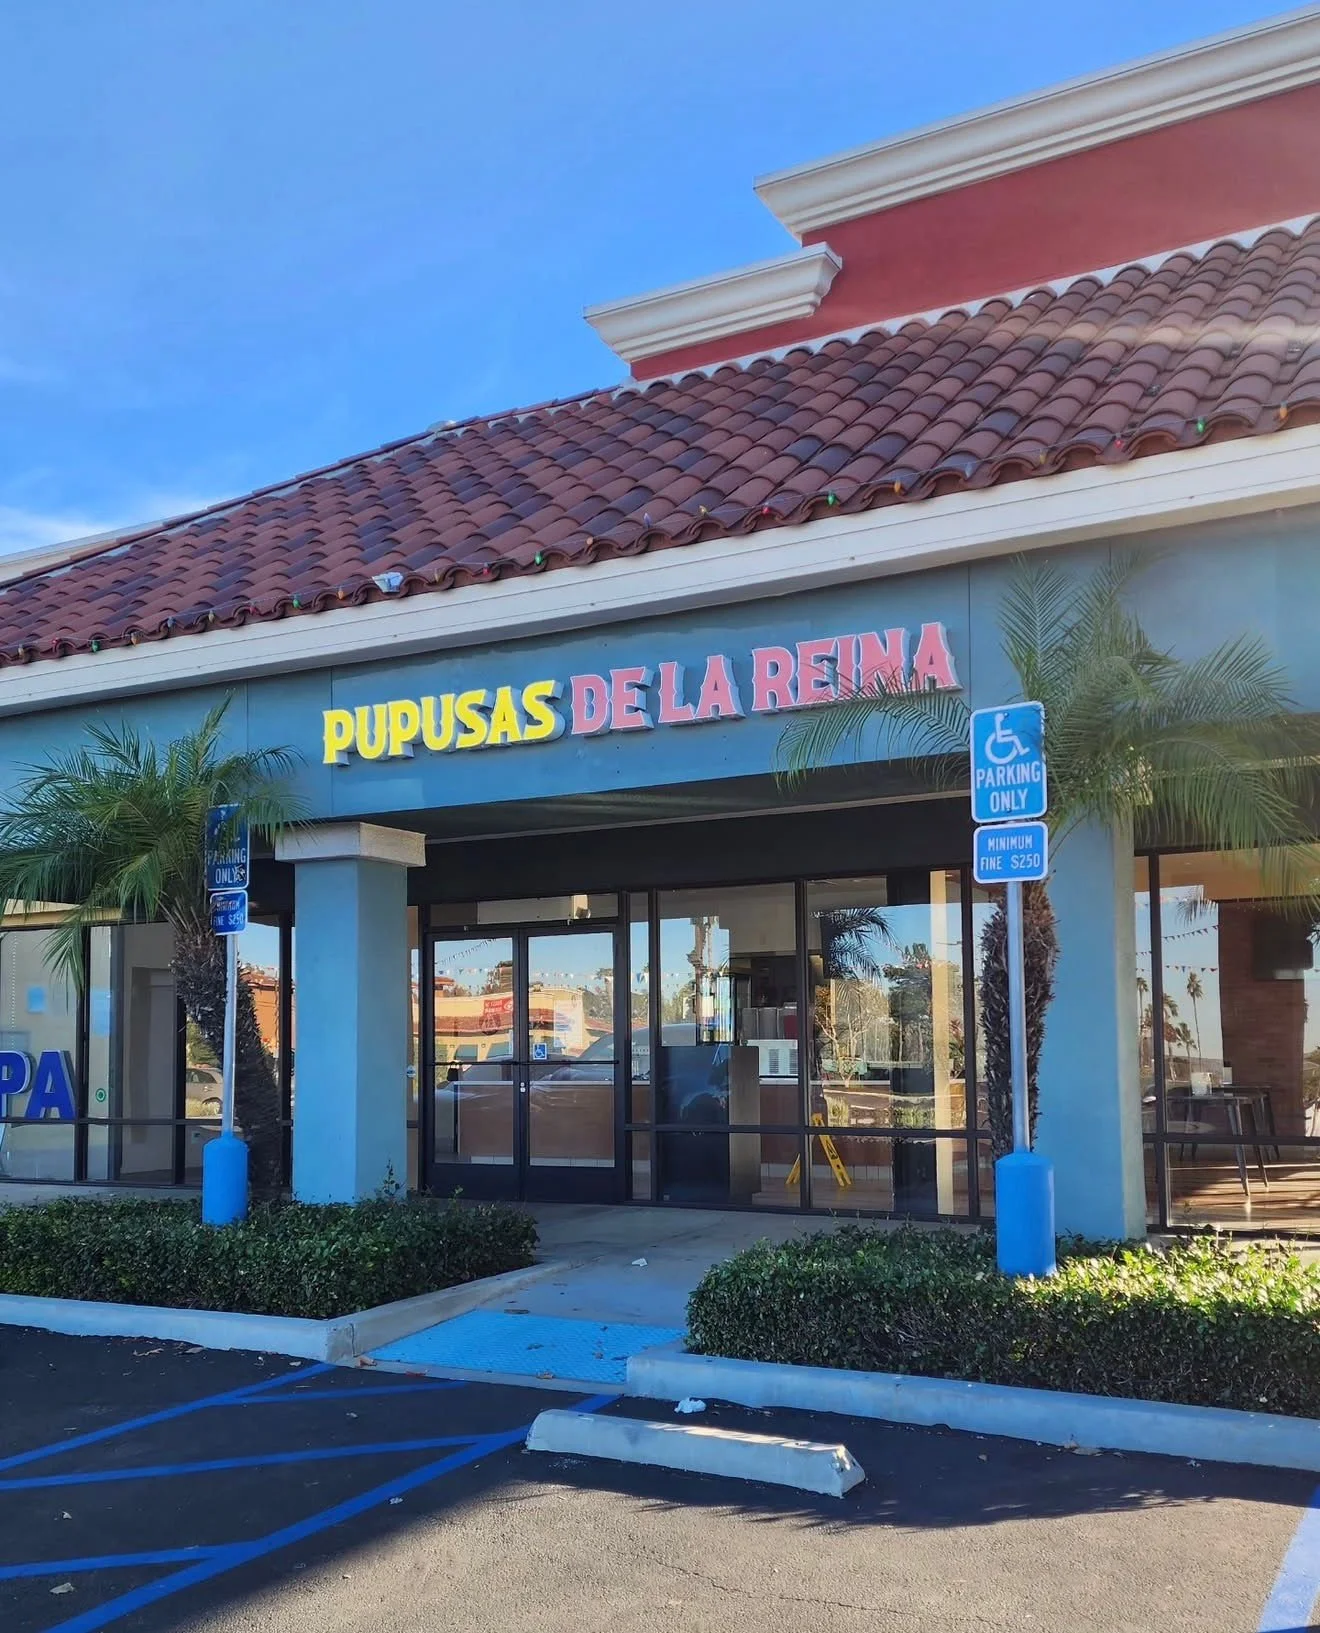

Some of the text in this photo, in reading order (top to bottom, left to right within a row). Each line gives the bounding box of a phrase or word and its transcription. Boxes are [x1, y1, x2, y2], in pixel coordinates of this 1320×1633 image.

[322, 621, 961, 766] PUPUSAS DE LA REINA
[977, 761, 1041, 788] PARKING
[990, 789, 1028, 813] ONLY
[988, 835, 1033, 852] MINIMUM
[980, 853, 1041, 872] FINE $250
[215, 867, 238, 884] ONLY
[228, 913, 244, 926] $250
